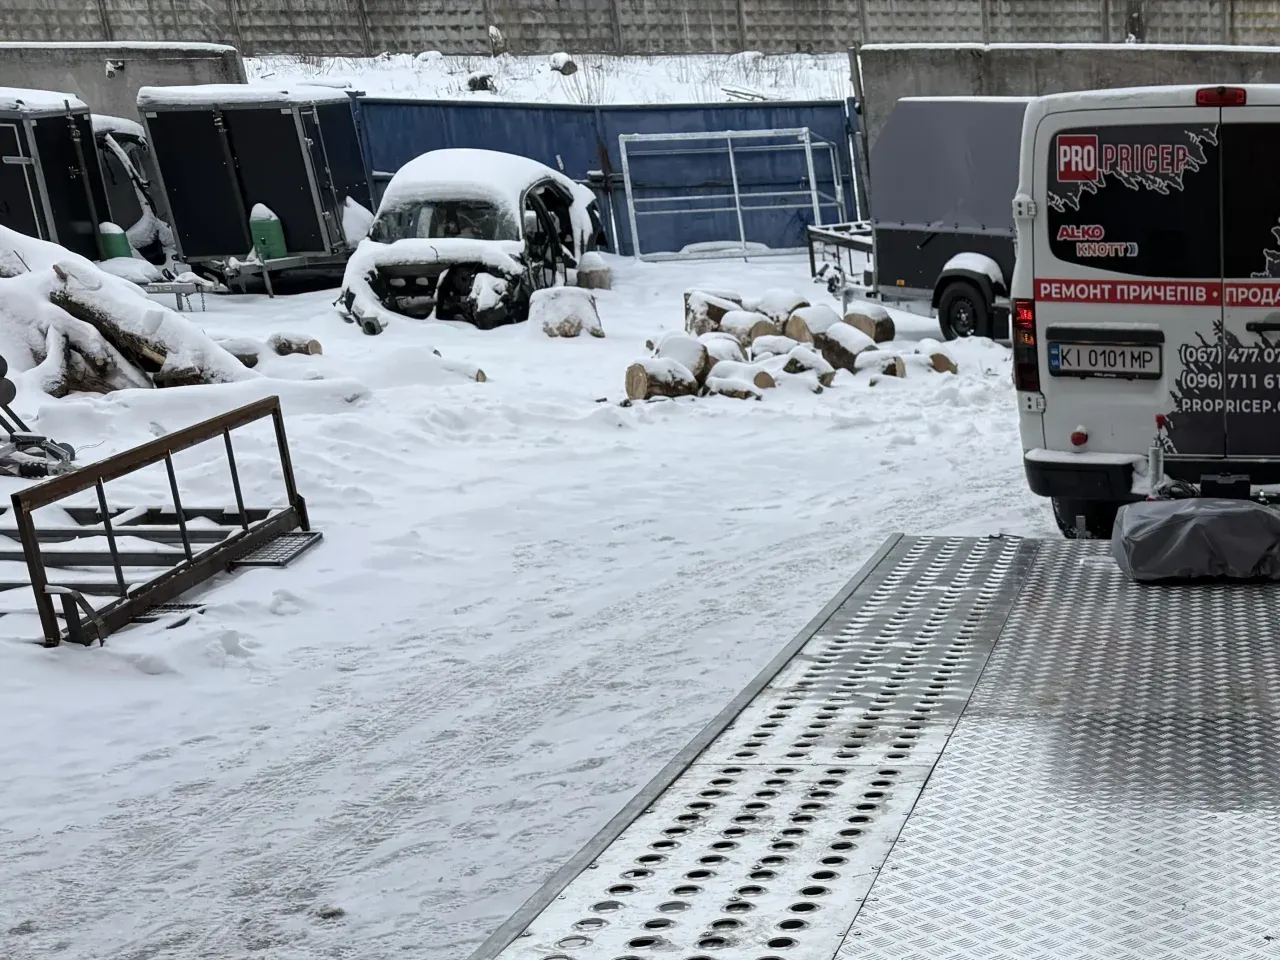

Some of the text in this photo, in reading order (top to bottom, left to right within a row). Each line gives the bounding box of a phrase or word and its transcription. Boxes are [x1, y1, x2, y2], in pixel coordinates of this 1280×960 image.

[1059, 144, 1189, 174] PRO PRICEP
[1076, 242, 1126, 257] KNOTT
[1040, 283, 1112, 300] РЕМОНТ
[1116, 285, 1207, 302] ПРИЧЕПІВ
[1088, 349, 1126, 368] 0101
[1130, 350, 1153, 369] MP
[1181, 345, 1222, 364] (067)
[1227, 348, 1259, 363] 477
[1181, 371, 1223, 390] (096)
[1227, 374, 1257, 389] 711
